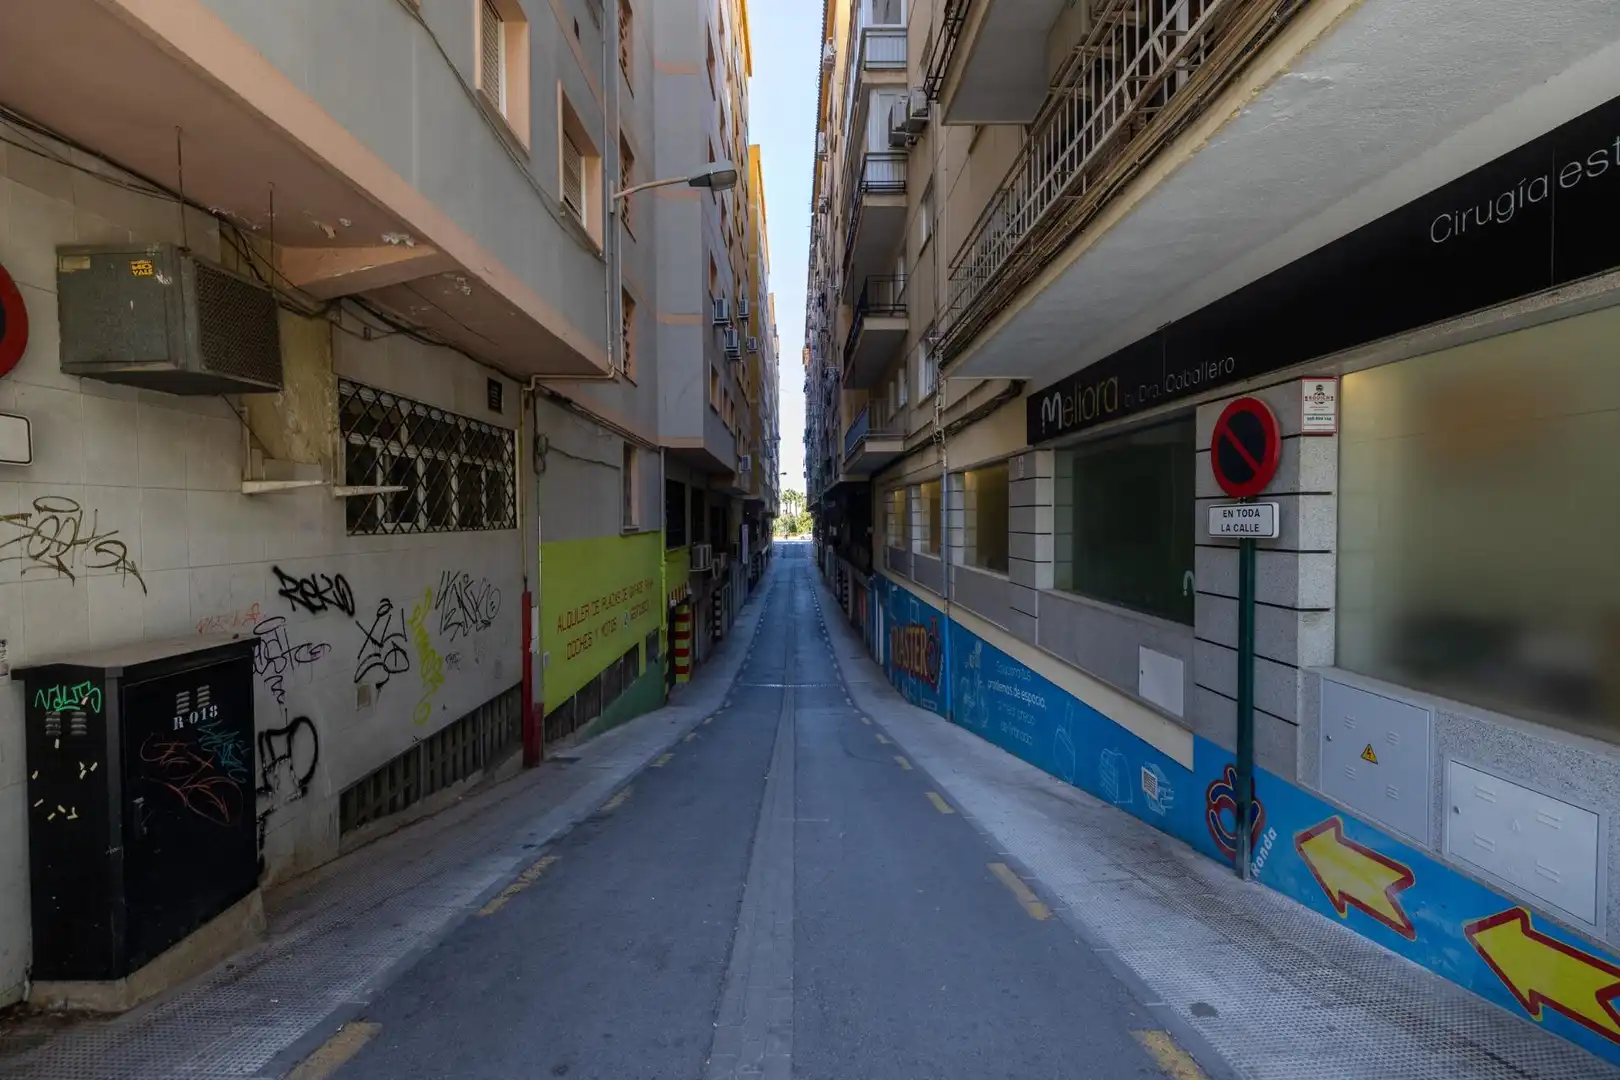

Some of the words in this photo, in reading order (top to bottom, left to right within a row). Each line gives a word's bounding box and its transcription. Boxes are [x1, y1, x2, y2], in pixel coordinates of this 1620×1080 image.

[1430, 175, 1548, 243] Cirugía
[1041, 376, 1118, 435] Meliora
[1165, 356, 1235, 393] Caballero
[1220, 523, 1231, 532] LA
[1233, 523, 1260, 532] CALLE
[1222, 509, 1234, 518] EN
[1236, 508, 1260, 518] TODA
[189, 705, 218, 724] 018
[1251, 827, 1277, 877] Ronda
